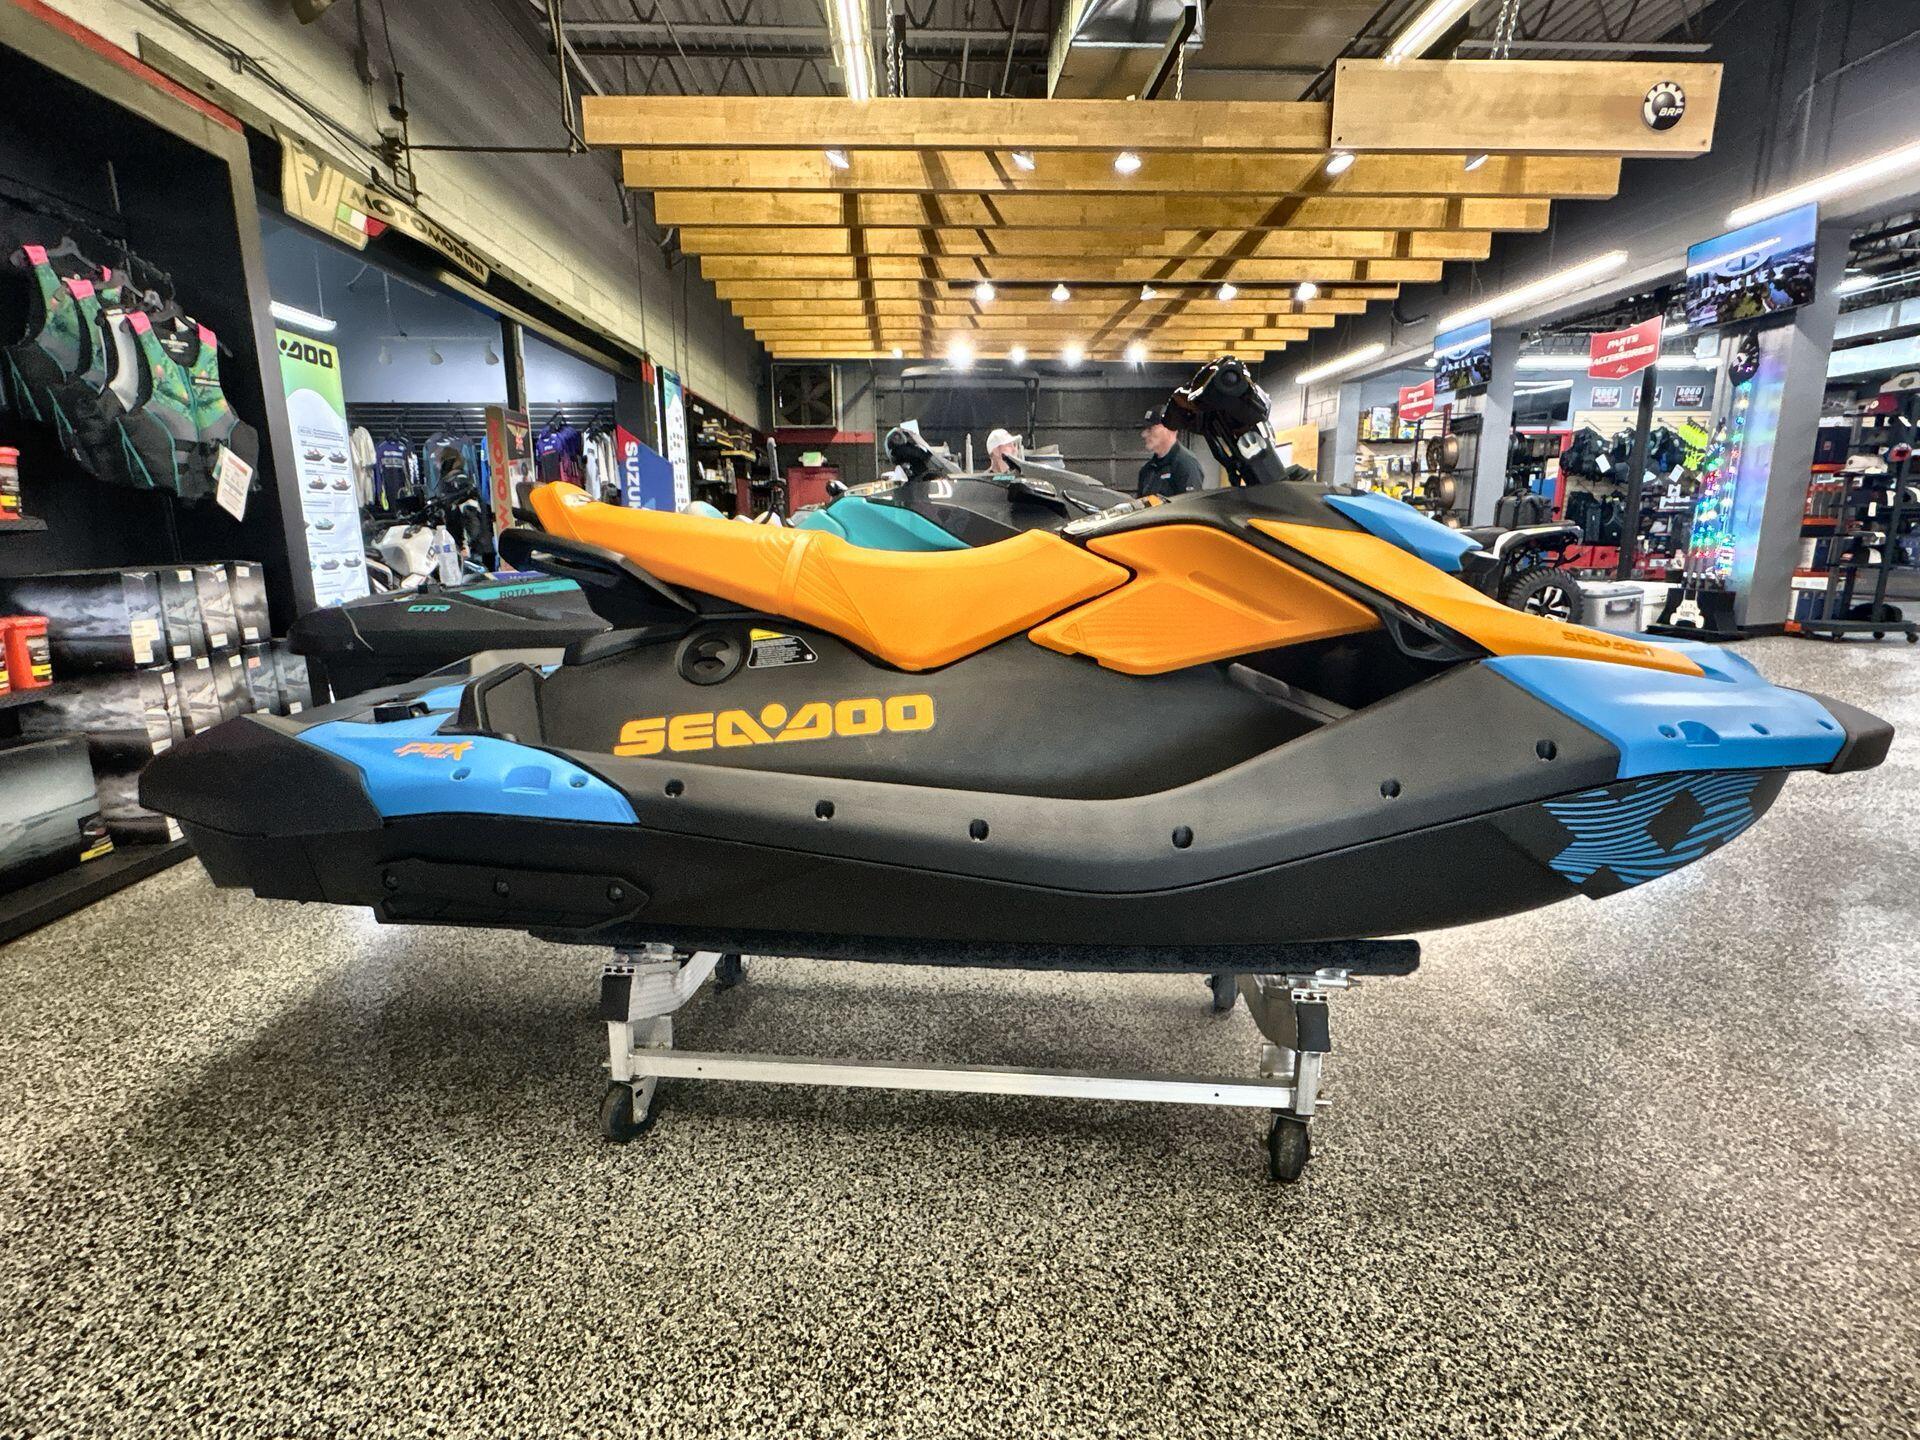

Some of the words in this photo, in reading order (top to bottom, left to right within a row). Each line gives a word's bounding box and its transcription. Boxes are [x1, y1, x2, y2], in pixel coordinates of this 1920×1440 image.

[1659, 107, 1683, 116] BRP
[1701, 265, 1788, 299] OAKLEY
[1607, 334, 1639, 349] PARTS
[280, 339, 333, 369] DOO
[1593, 344, 1655, 365] ACCESSORIES
[1441, 356, 1480, 373] OAKLEY
[408, 605, 451, 613] GTR
